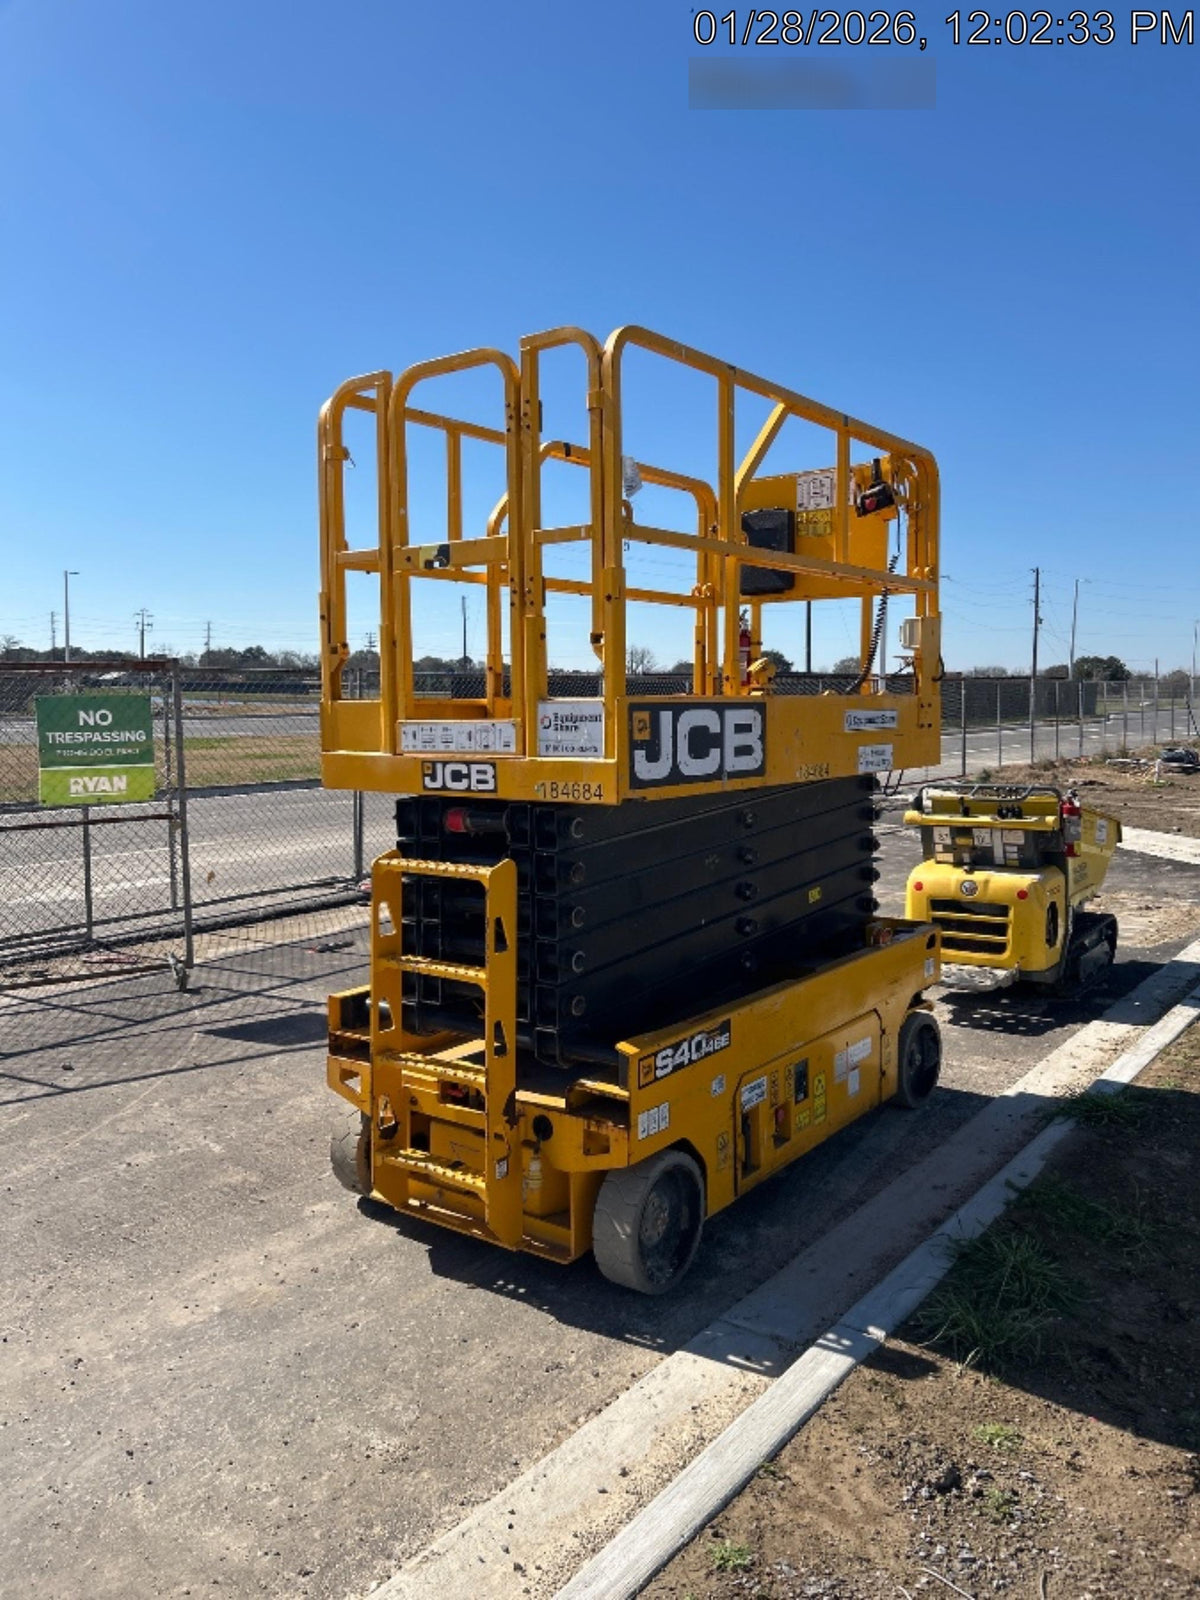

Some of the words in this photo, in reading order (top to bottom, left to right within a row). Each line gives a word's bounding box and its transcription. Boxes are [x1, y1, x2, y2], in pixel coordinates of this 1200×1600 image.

[78, 709, 113, 726] NO
[46, 730, 147, 744] TRESPASSING
[633, 708, 764, 781] JCB
[69, 774, 128, 794] RYAN
[423, 762, 496, 791] JCB
[539, 782, 604, 801] 184684
